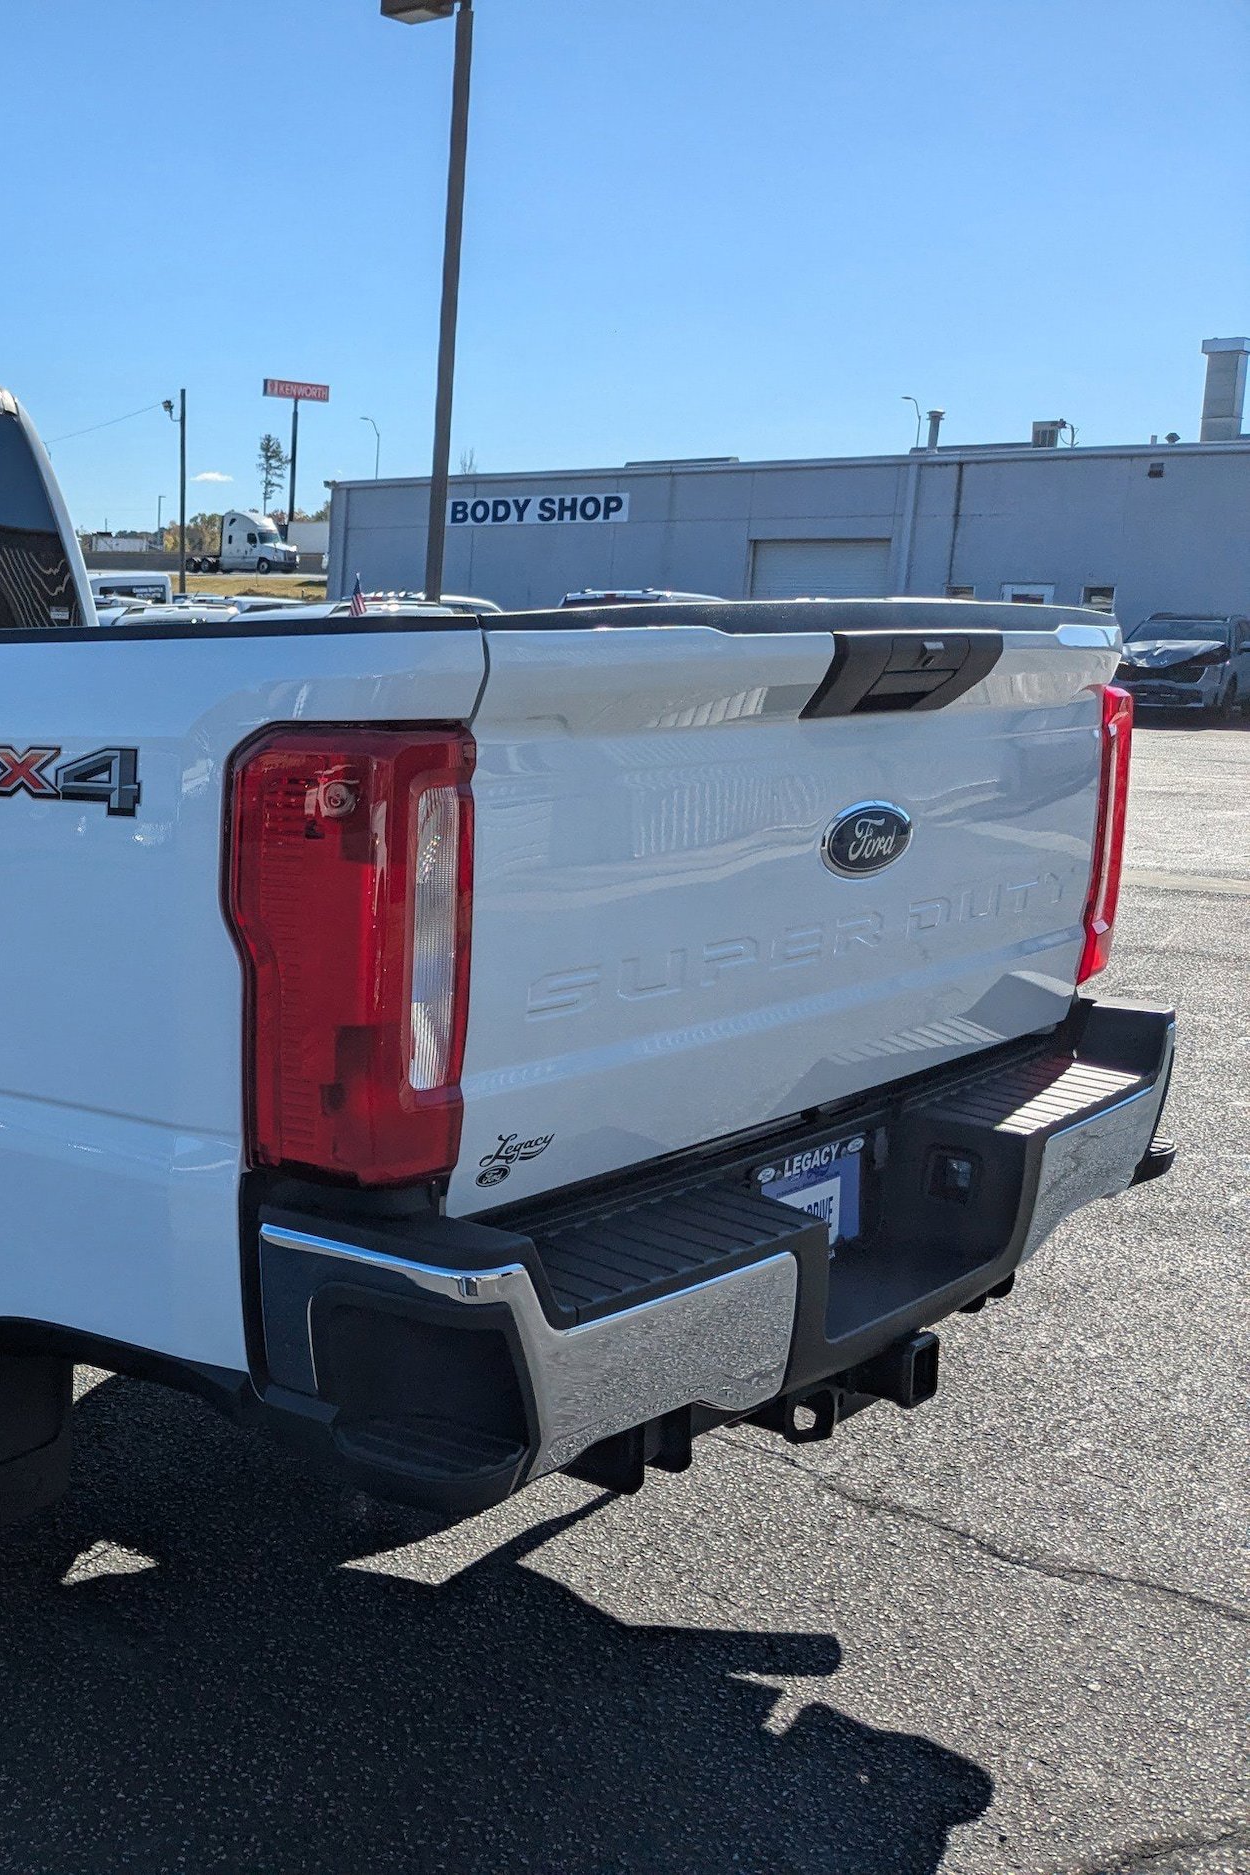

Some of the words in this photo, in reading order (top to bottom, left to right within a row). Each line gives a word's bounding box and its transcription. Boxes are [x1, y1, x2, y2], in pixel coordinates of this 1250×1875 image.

[278, 382, 328, 400] KENWORTH
[450, 499, 532, 524] BODY
[537, 496, 623, 522] SHOP
[848, 818, 897, 861] Ford
[524, 908, 885, 1023] SUPER
[905, 866, 1075, 939] DUTY
[479, 1133, 555, 1167] Legacy
[784, 1142, 840, 1177] LEGACY
